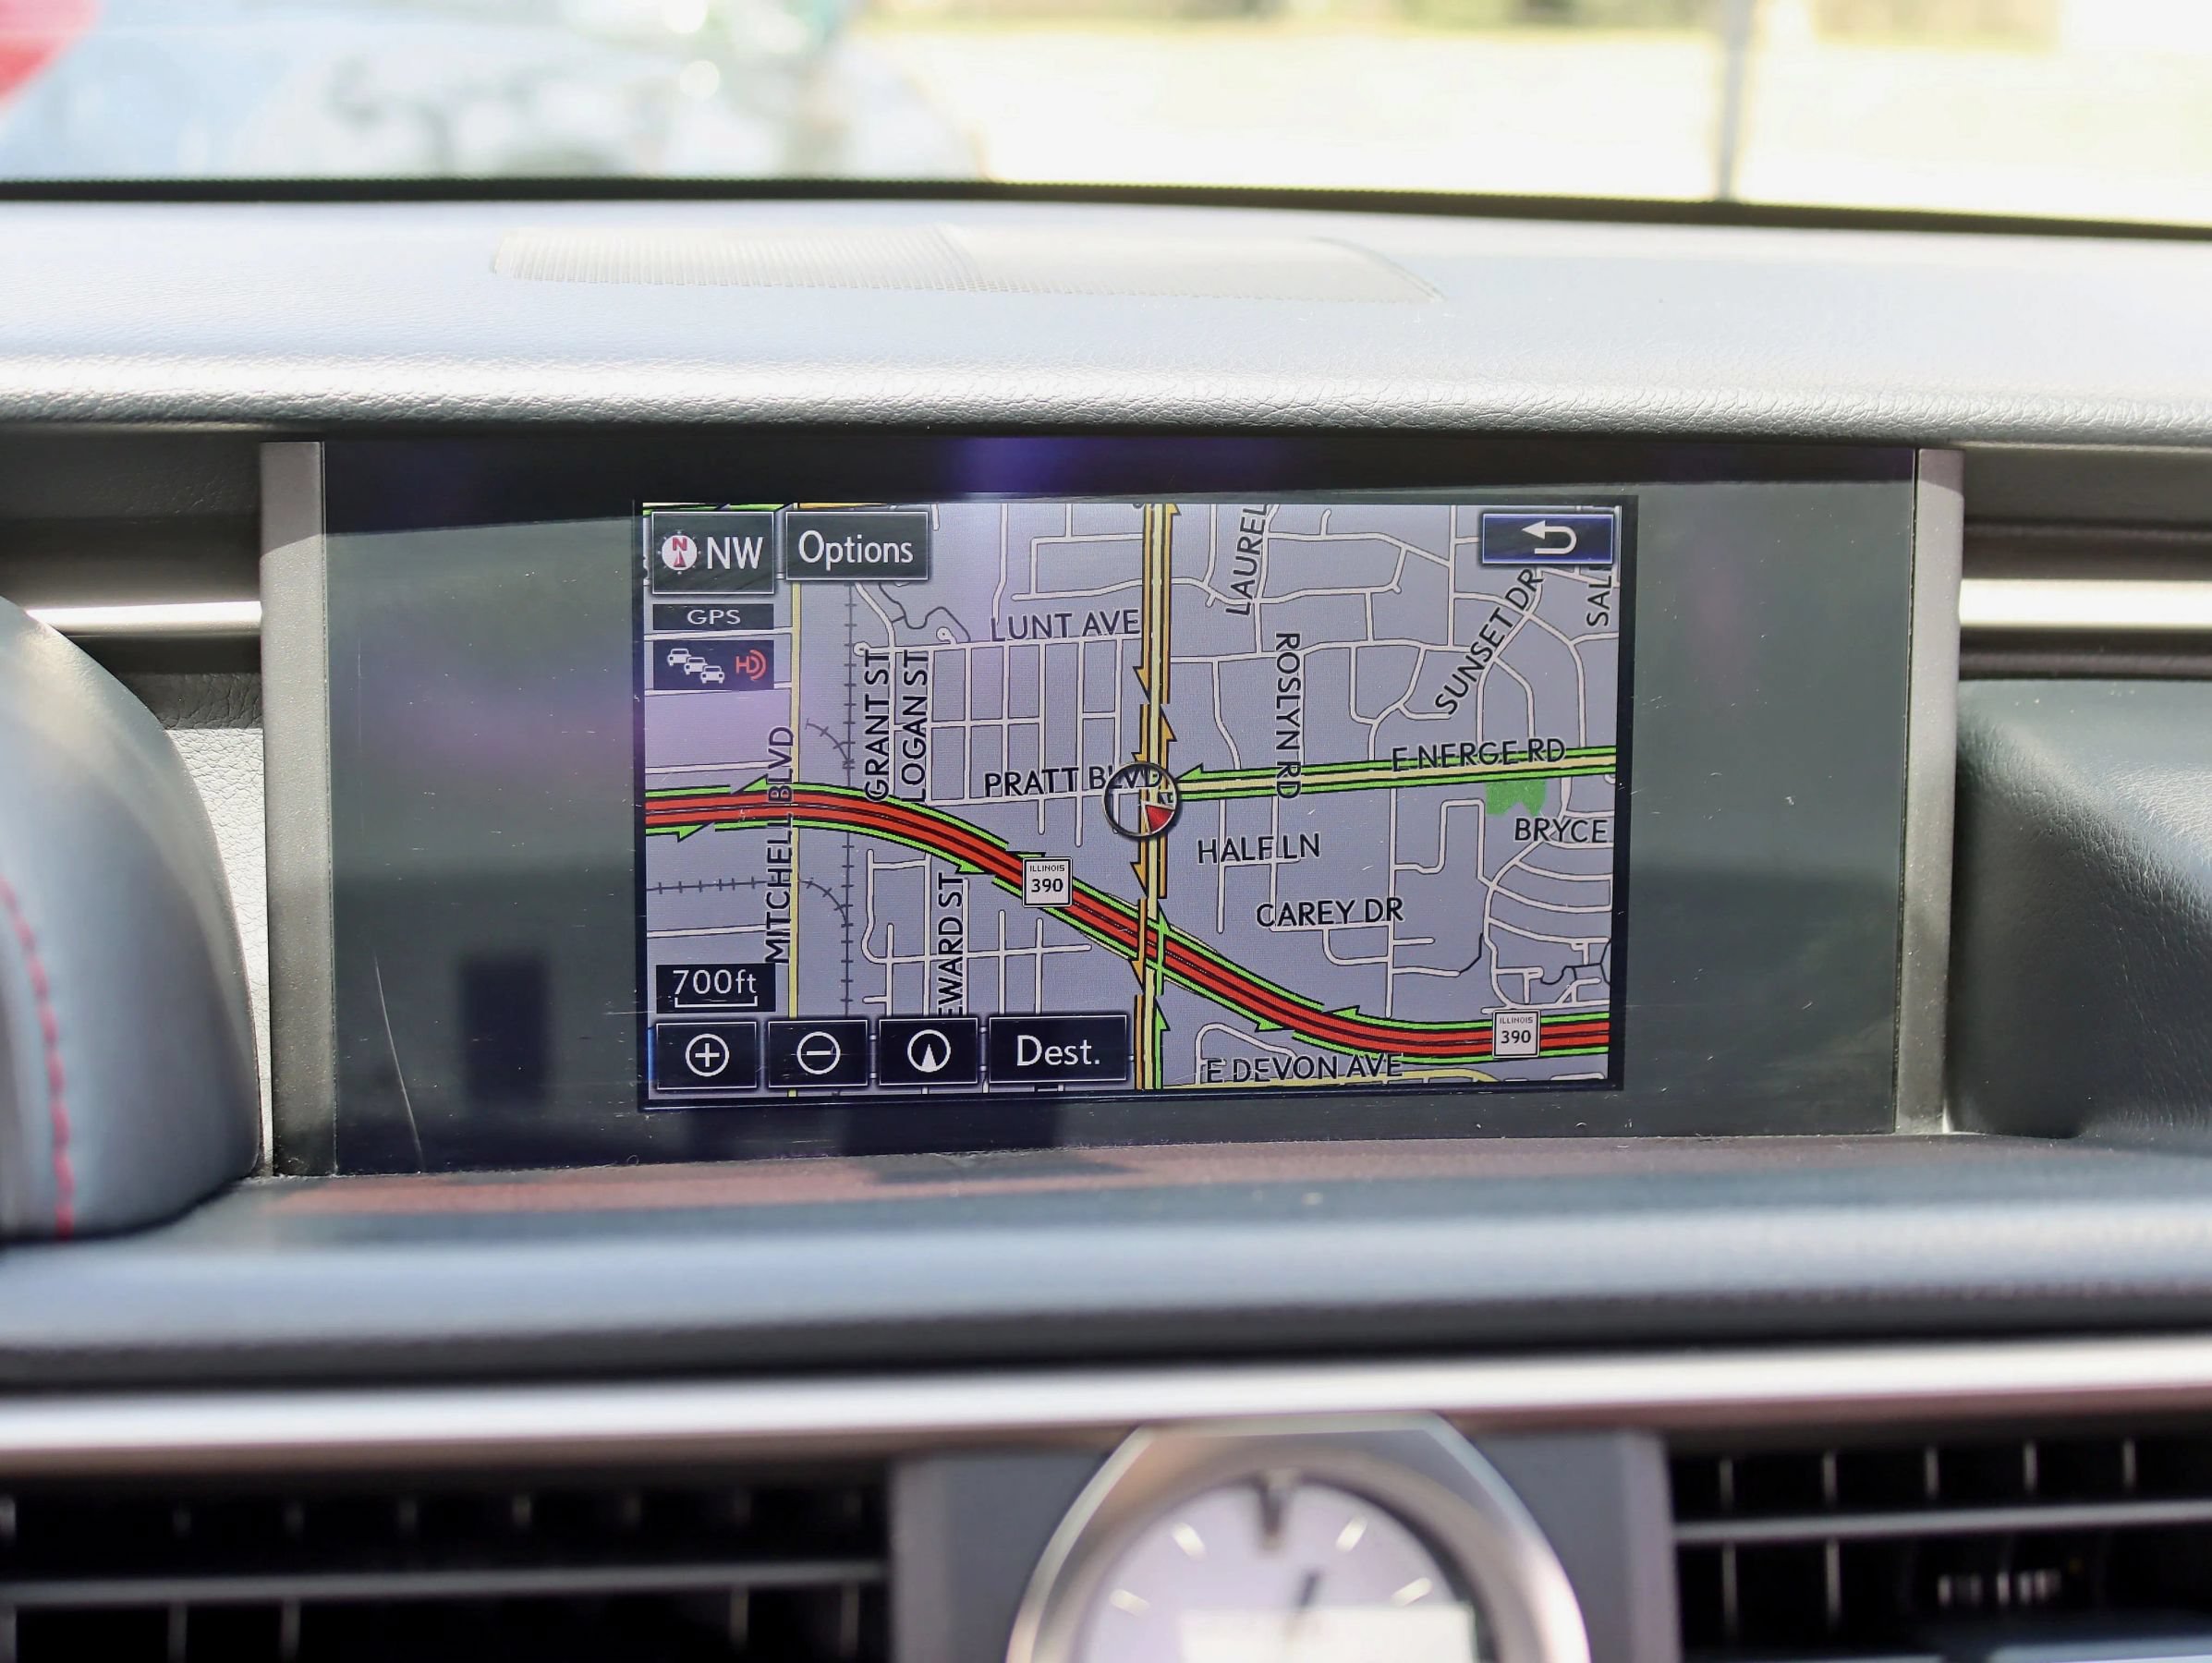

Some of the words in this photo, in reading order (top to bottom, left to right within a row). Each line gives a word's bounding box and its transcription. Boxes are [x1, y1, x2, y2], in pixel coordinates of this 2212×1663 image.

[706, 536, 764, 570] NW
[797, 529, 914, 571] Options
[1225, 504, 1269, 616] LAUREL
[687, 609, 741, 625] GPS
[990, 613, 1073, 641] LUNT
[1082, 609, 1141, 637] AVE
[1435, 607, 1513, 715] SUNSET
[1505, 567, 1544, 612] DR
[865, 649, 889, 686] ST
[904, 649, 930, 686] ST
[1275, 632, 1302, 750] ROSLYN
[768, 726, 795, 803] BLVD
[865, 694, 890, 802] GRANT
[901, 695, 928, 803] LOGAN
[1392, 747, 1408, 772] E
[1418, 740, 1519, 768] NERGE
[1527, 737, 1566, 763] RD
[984, 767, 1079, 797] PRATT
[1275, 760, 1300, 799] RD
[1284, 833, 1320, 859] LN
[1514, 818, 1609, 843] BRYCE
[1029, 864, 1065, 872] ILLINOIS
[764, 812, 794, 964] MITCHELL
[938, 872, 964, 907] ST
[1031, 879, 1063, 893] 390
[1256, 900, 1357, 928] CAREY
[1365, 897, 1404, 923] DR
[673, 969, 757, 995] 700ft
[1016, 1034, 1101, 1066] Dest.
[1501, 1030, 1532, 1045] 390
[1207, 1060, 1224, 1084] E
[1233, 1057, 1338, 1083] DEVON
[1346, 1052, 1404, 1078] AVE
